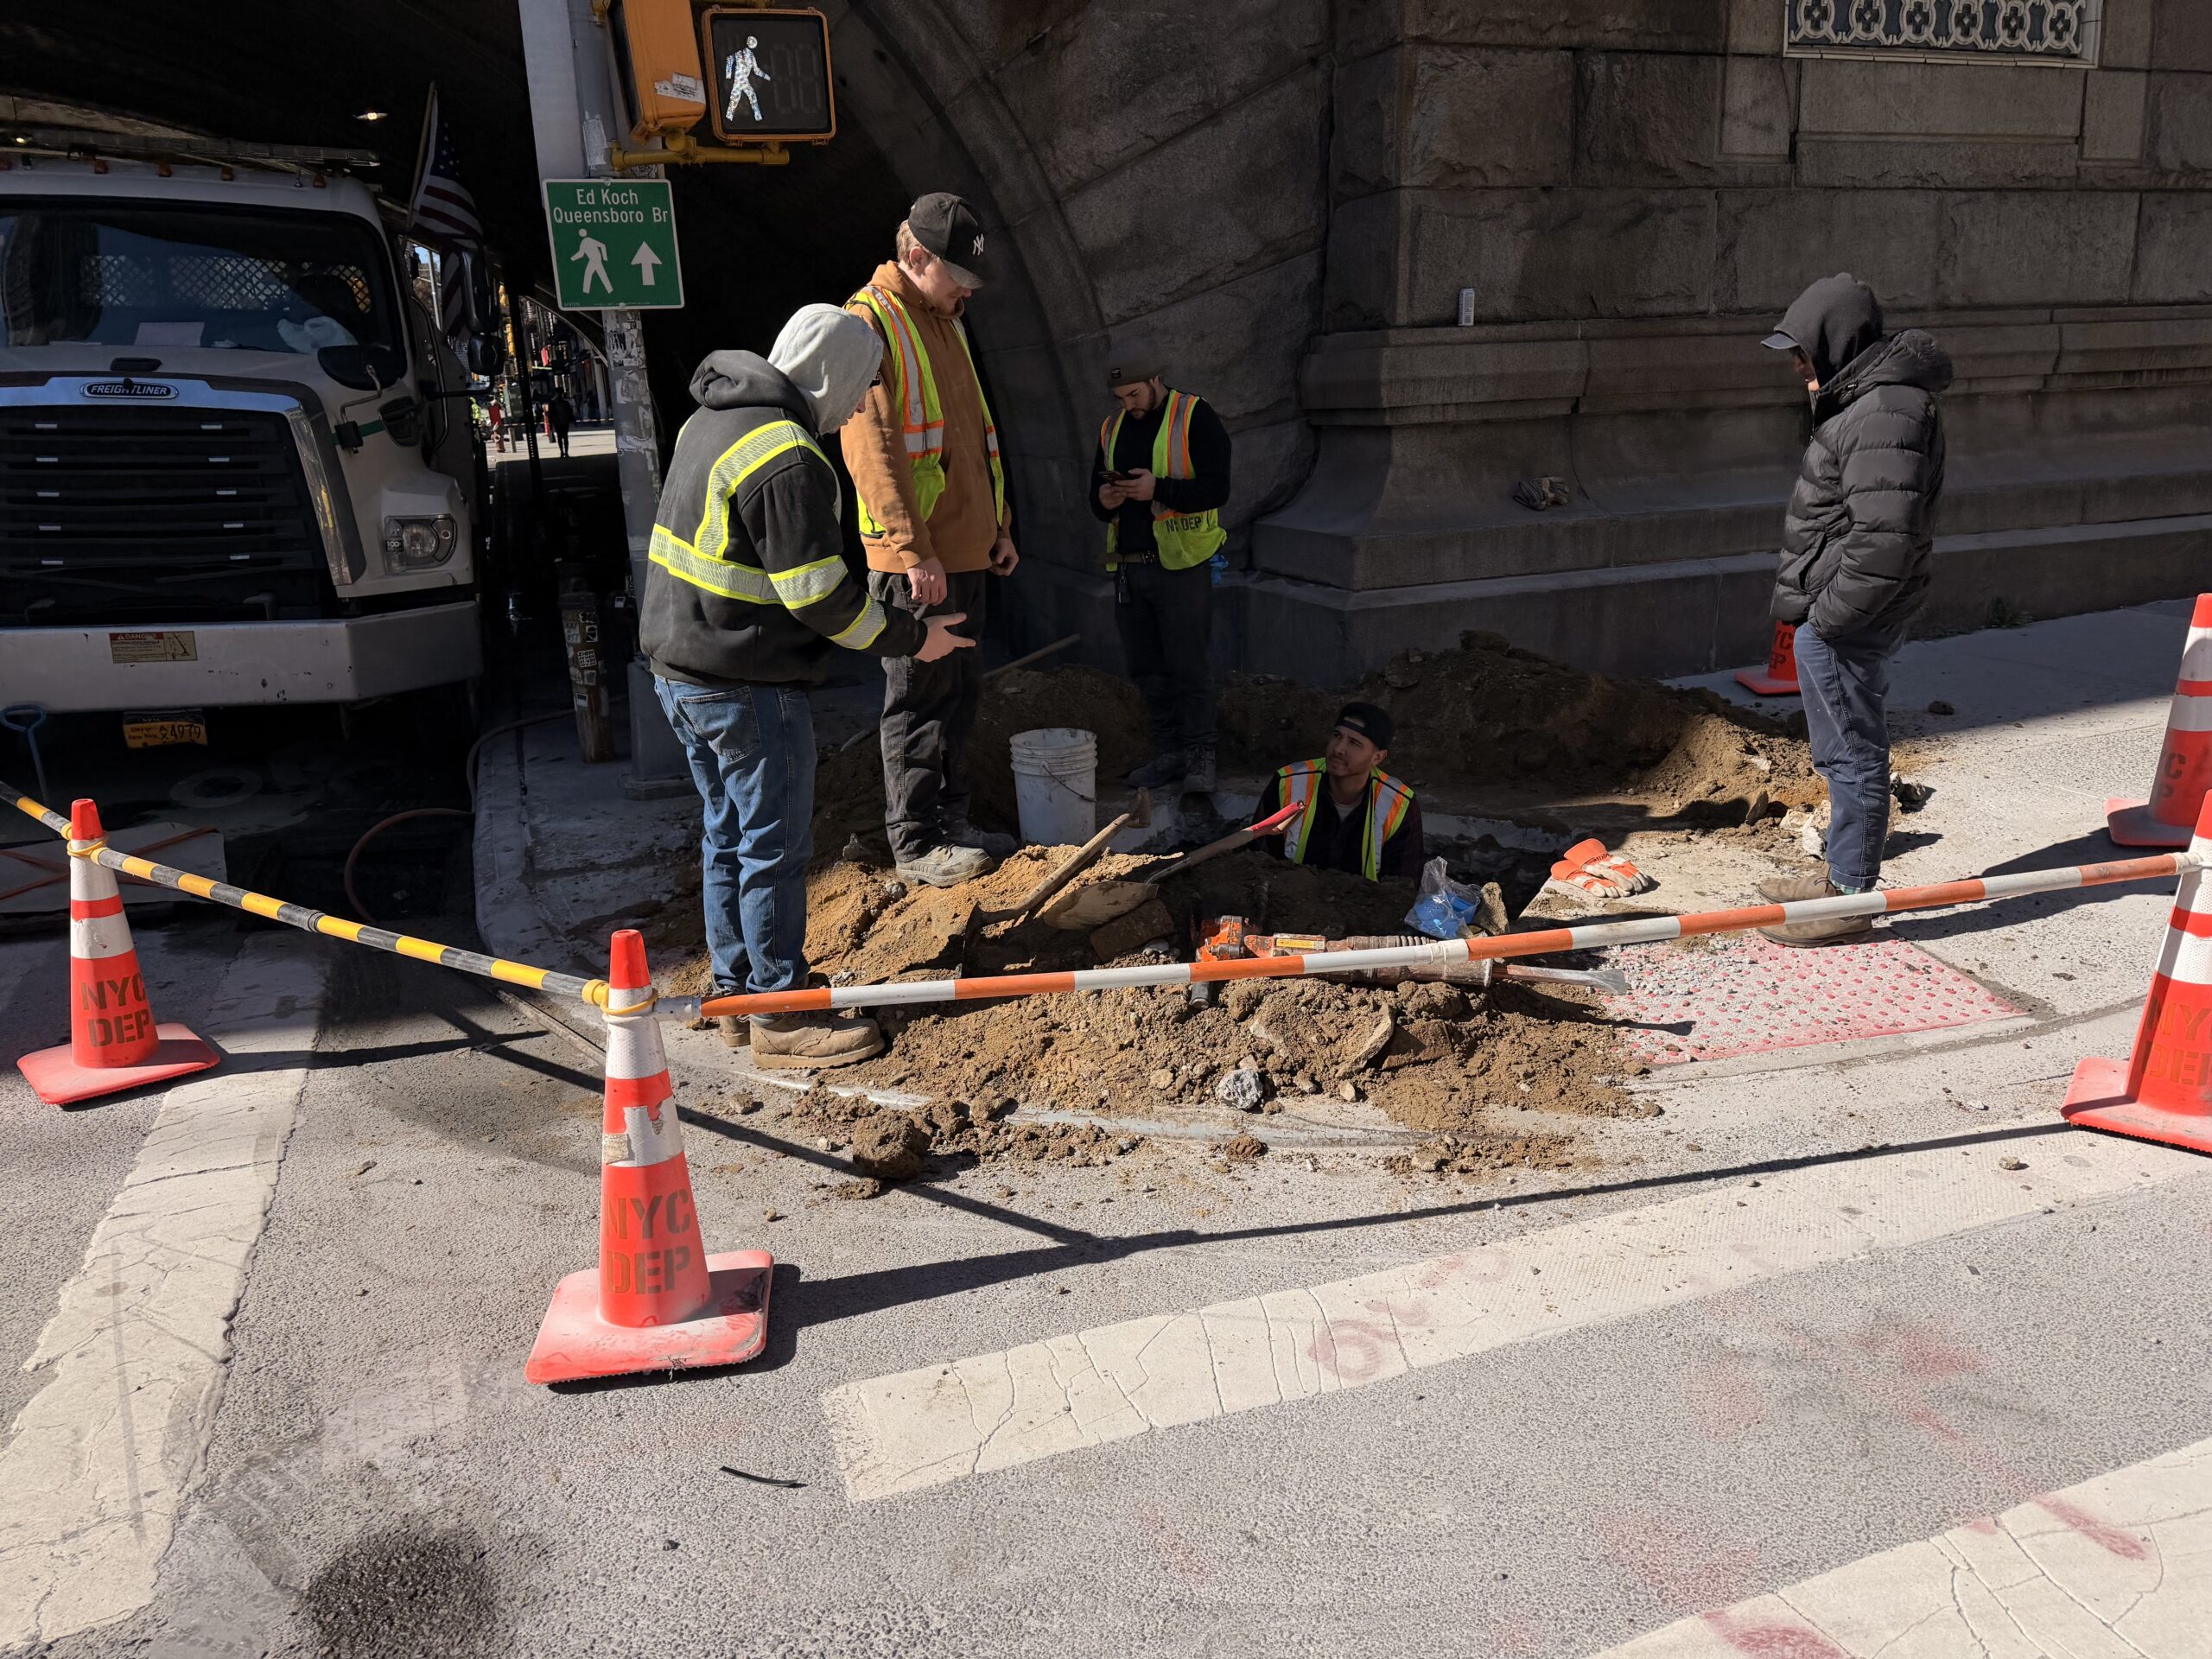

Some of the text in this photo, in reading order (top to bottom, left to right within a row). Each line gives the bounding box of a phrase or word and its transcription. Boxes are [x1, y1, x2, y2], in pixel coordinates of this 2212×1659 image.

[553, 207, 668, 224] Queensboro Br
[576, 188, 639, 205] Ed Koch
[972, 233, 984, 256] NY
[81, 973, 146, 1010] NYC
[87, 1008, 150, 1047] DEP
[2146, 996, 2212, 1041] NY
[604, 1188, 691, 1239] NYC
[607, 1245, 691, 1294] DEP
